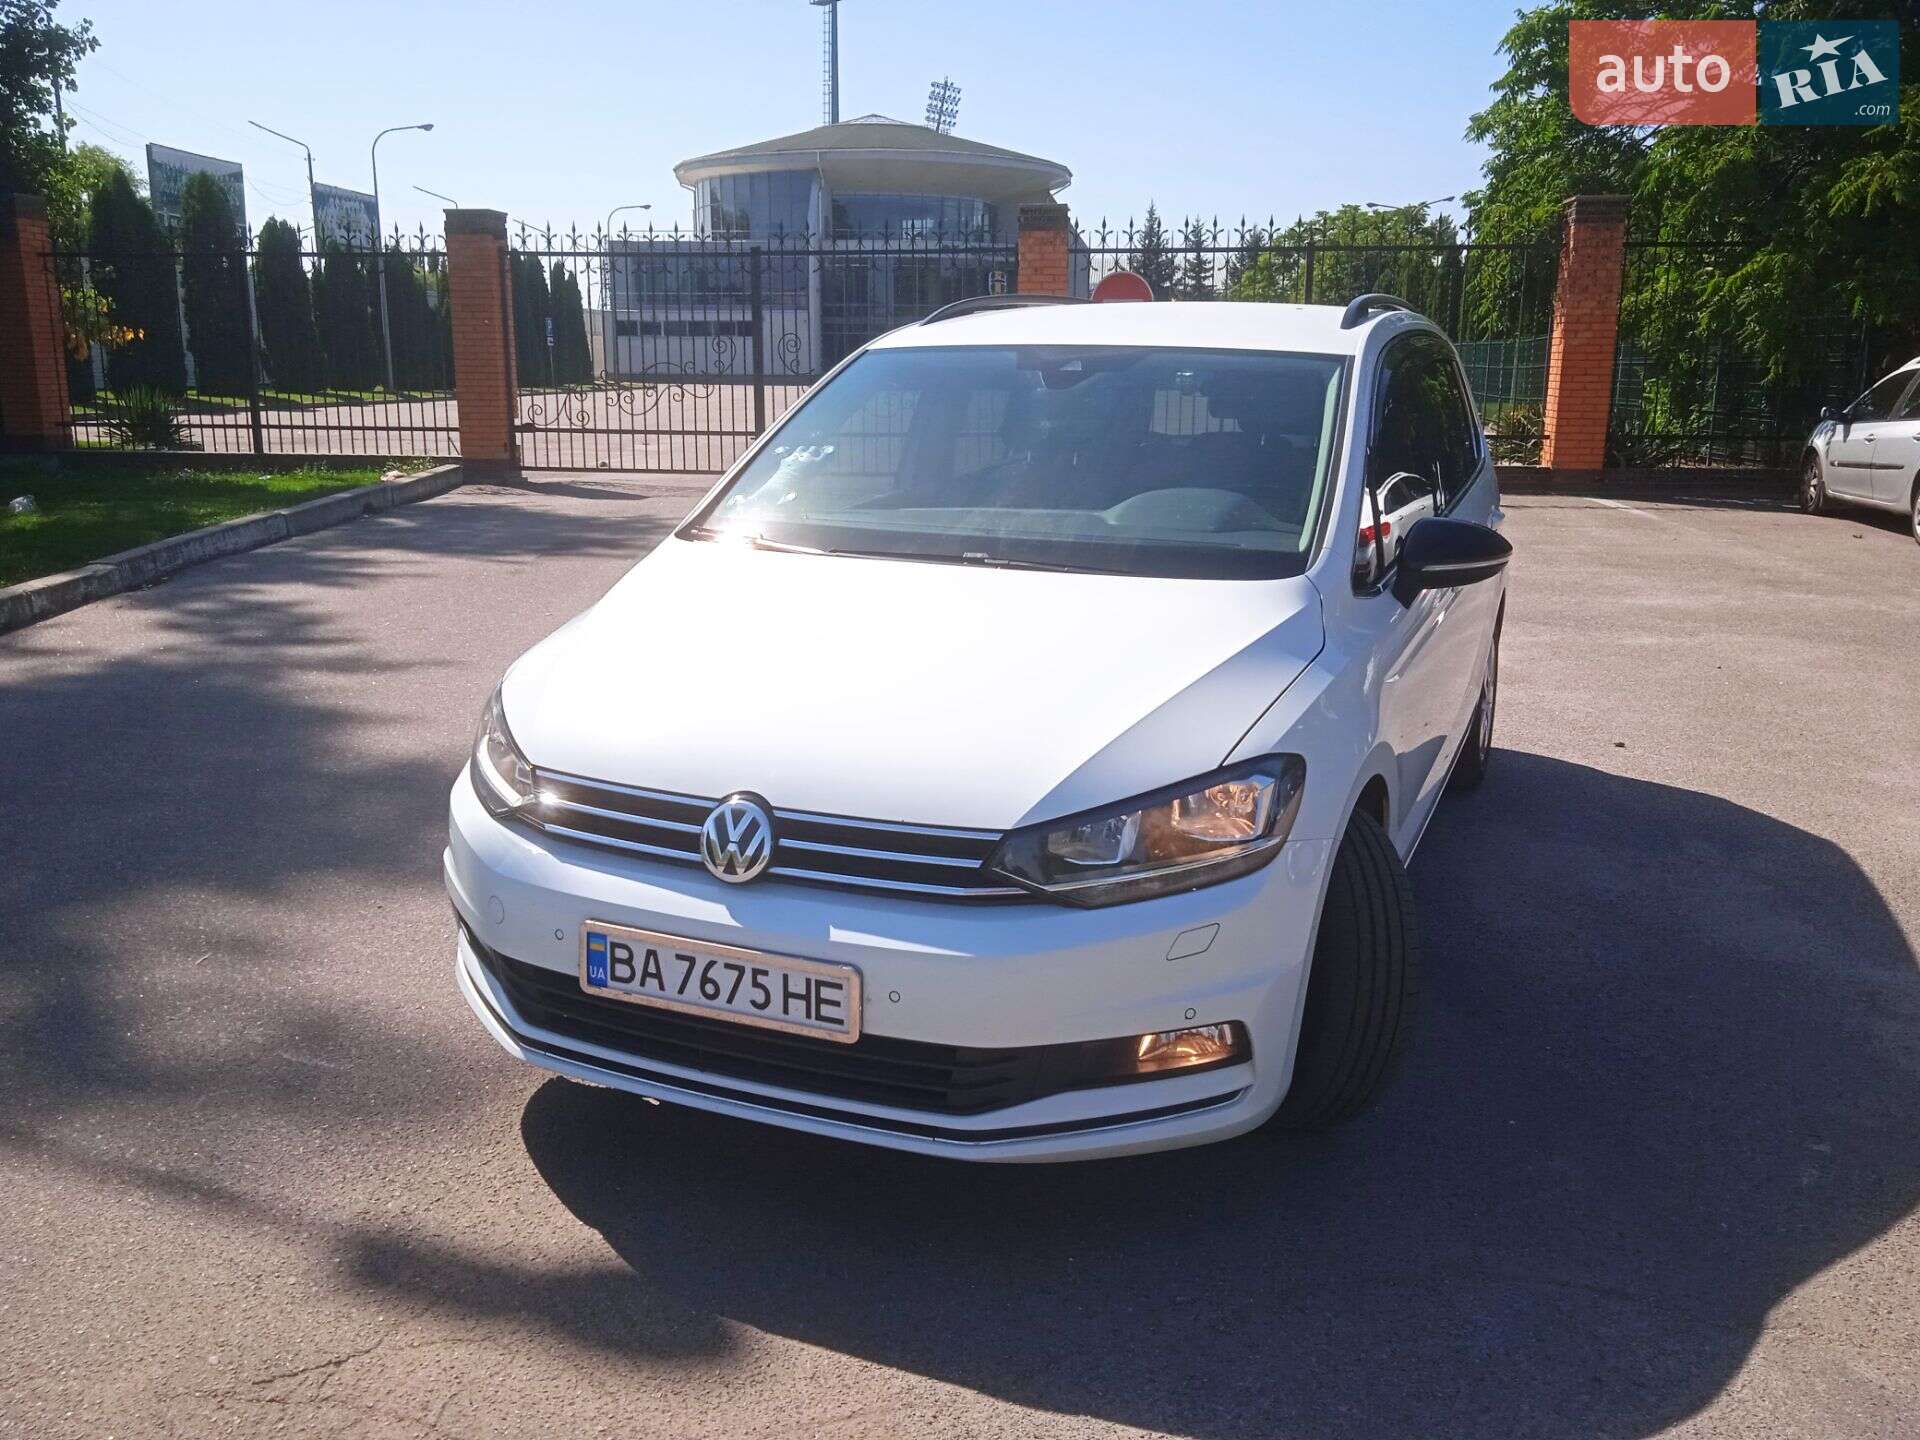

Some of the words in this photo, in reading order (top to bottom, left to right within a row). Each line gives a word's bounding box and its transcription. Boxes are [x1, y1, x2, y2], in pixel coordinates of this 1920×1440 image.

[589, 966, 606, 980] UA
[609, 941, 666, 991] BA
[674, 953, 772, 1010] 7675
[782, 972, 845, 1025] HE
